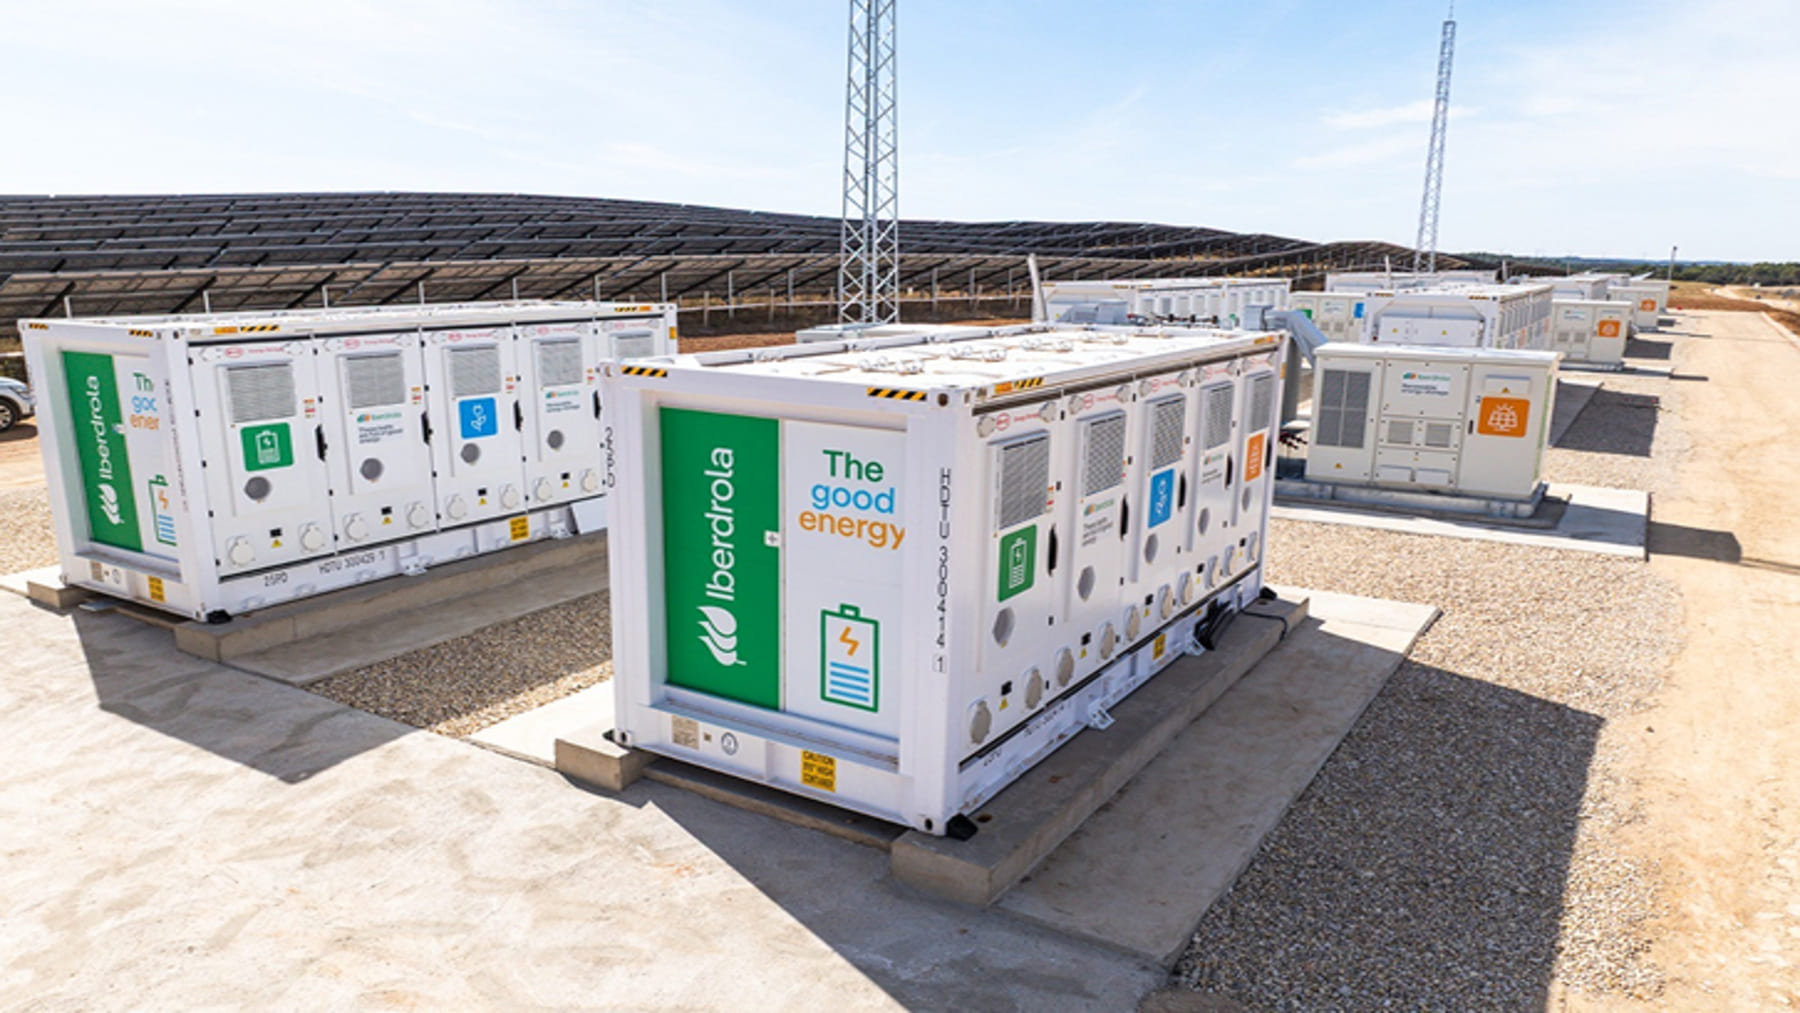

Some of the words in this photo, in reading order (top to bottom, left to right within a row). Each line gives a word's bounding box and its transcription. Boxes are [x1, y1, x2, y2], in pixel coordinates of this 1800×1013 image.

[132, 372, 154, 392] Th
[86, 375, 113, 480] Iberdrola
[822, 449, 884, 483] The
[811, 484, 896, 515] good
[939, 467, 951, 540] HDTU
[704, 447, 735, 601] Iberdrola
[798, 510, 905, 550] energy
